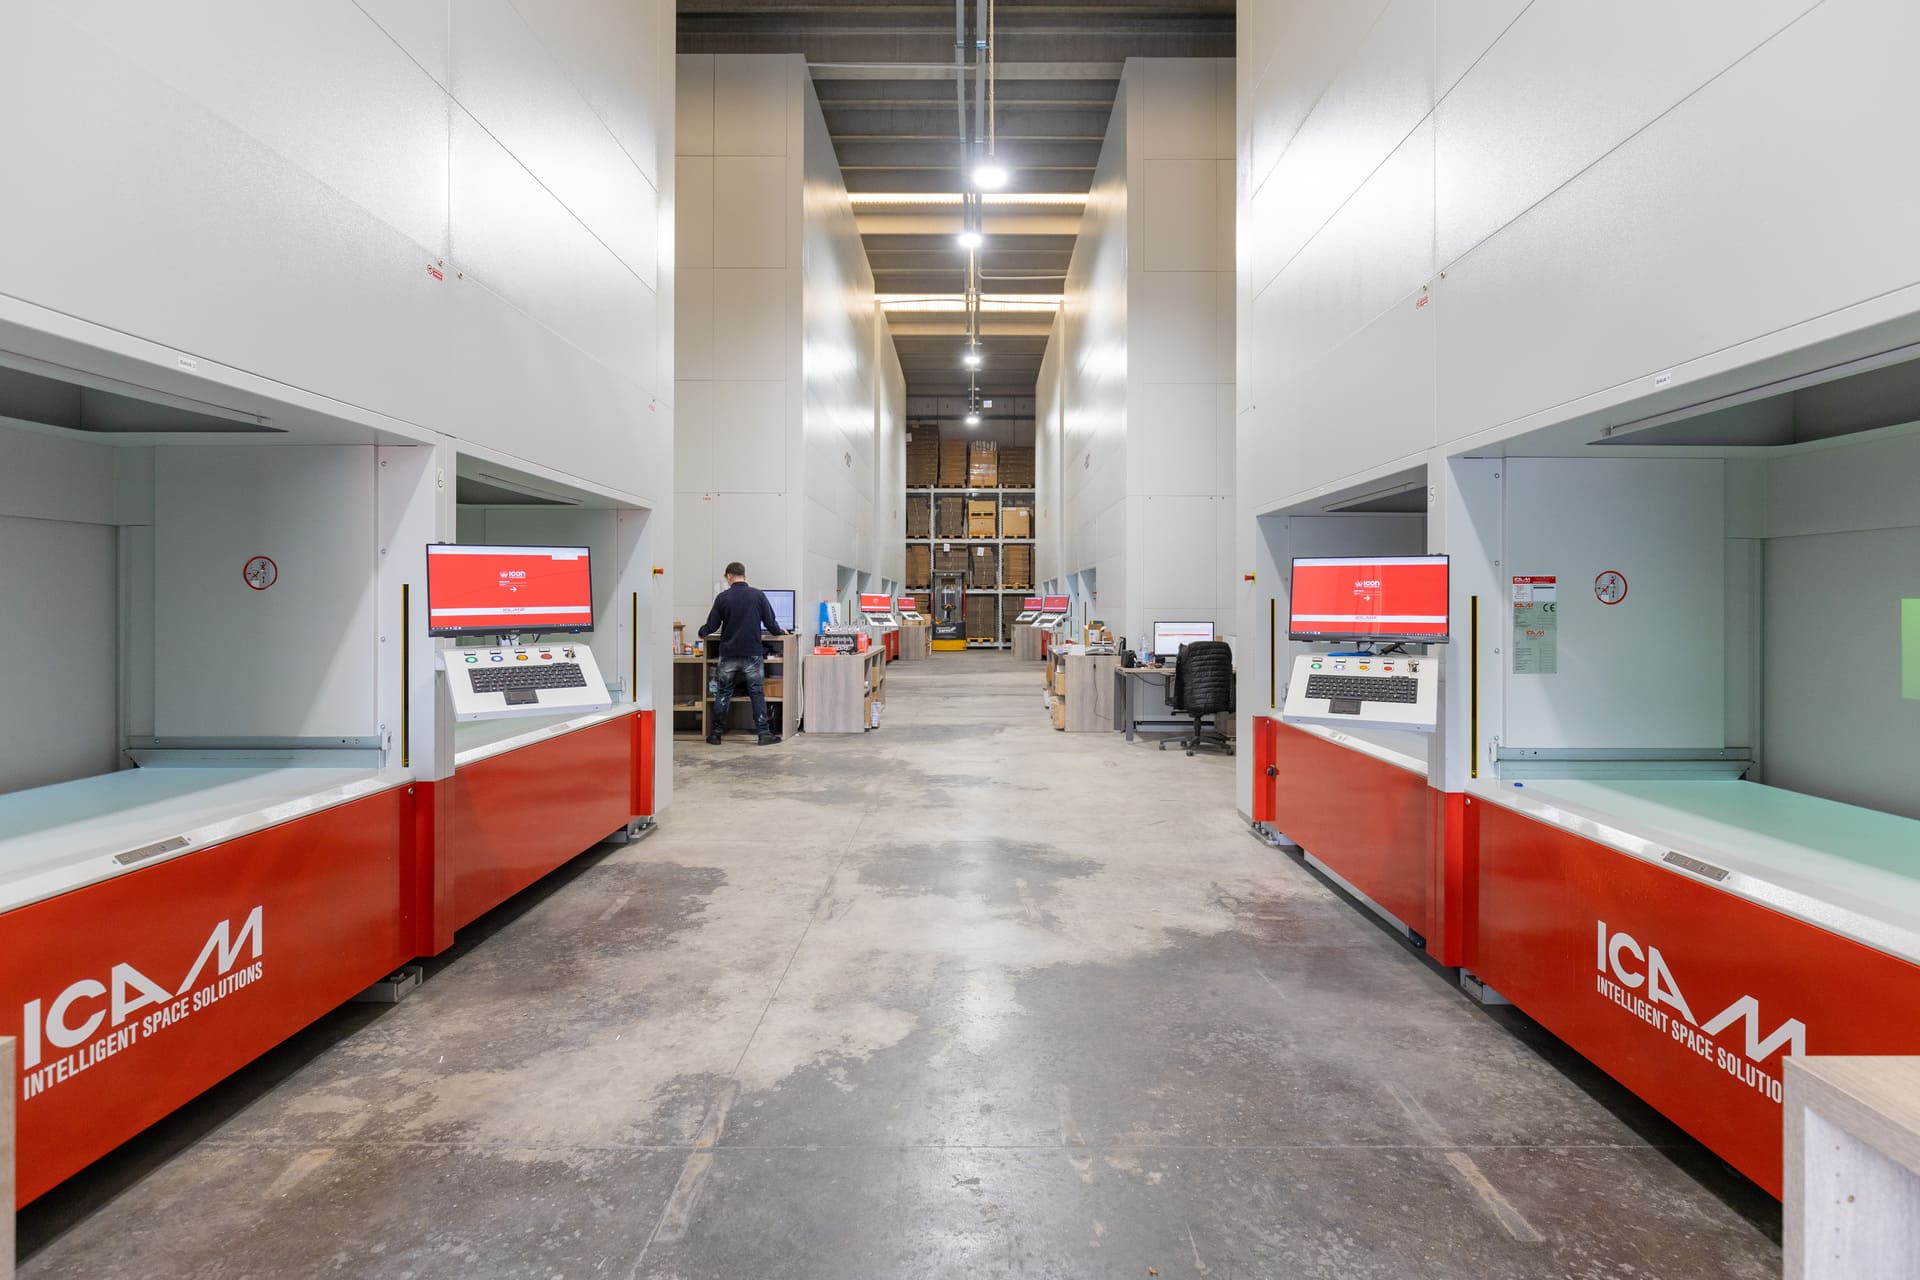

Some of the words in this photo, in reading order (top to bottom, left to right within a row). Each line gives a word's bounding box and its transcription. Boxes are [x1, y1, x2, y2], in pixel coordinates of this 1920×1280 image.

[23, 905, 263, 1070] ICAM
[23, 1022, 140, 1102] INTELLIGENT
[142, 997, 190, 1038] SPACE
[192, 961, 263, 1012] SOLUTIONS
[1596, 974, 1669, 1033] INTELLIGENT
[1671, 1018, 1714, 1063] SPACE
[1597, 919, 1807, 1064] ICAM
